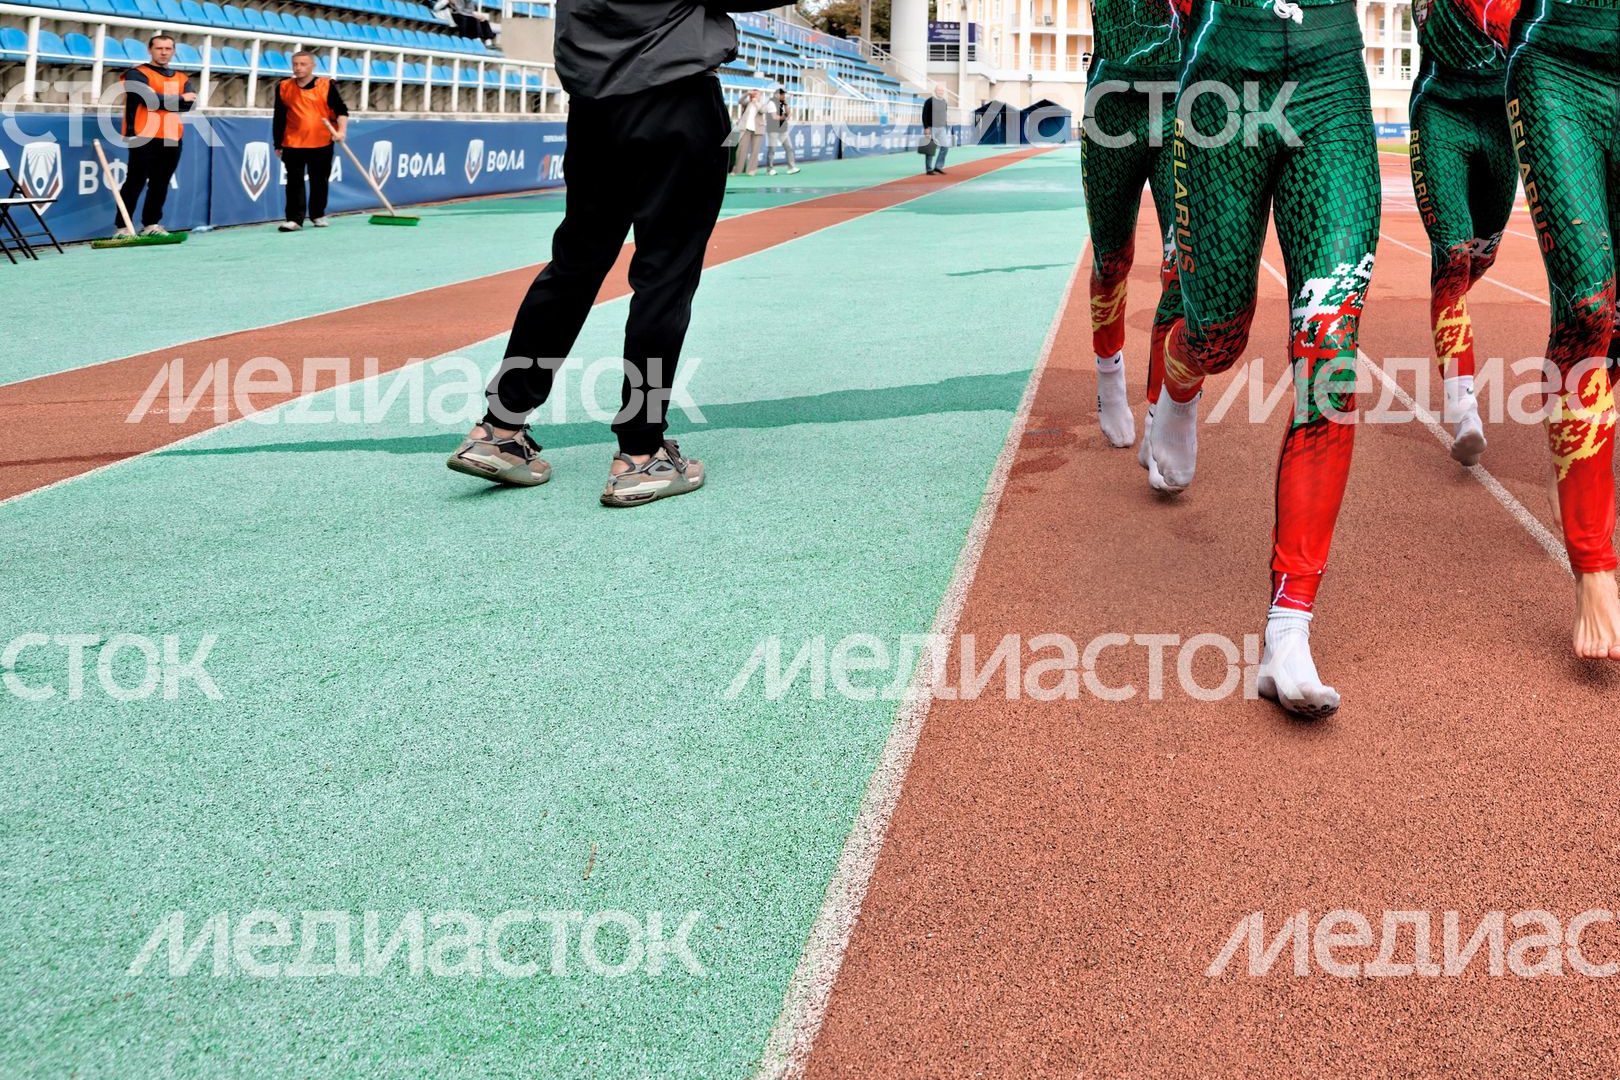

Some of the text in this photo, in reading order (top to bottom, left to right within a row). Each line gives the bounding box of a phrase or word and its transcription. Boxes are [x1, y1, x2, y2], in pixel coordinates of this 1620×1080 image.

[78, 158, 179, 195] ВФ
[279, 156, 342, 185] ВА
[397, 152, 446, 178] ВФЛА
[486, 149, 525, 173] ВФЛА
[1410, 129, 1437, 226] BELARUS
[1507, 98, 1556, 254] BELARUS
[1173, 118, 1195, 274] BELARUS
